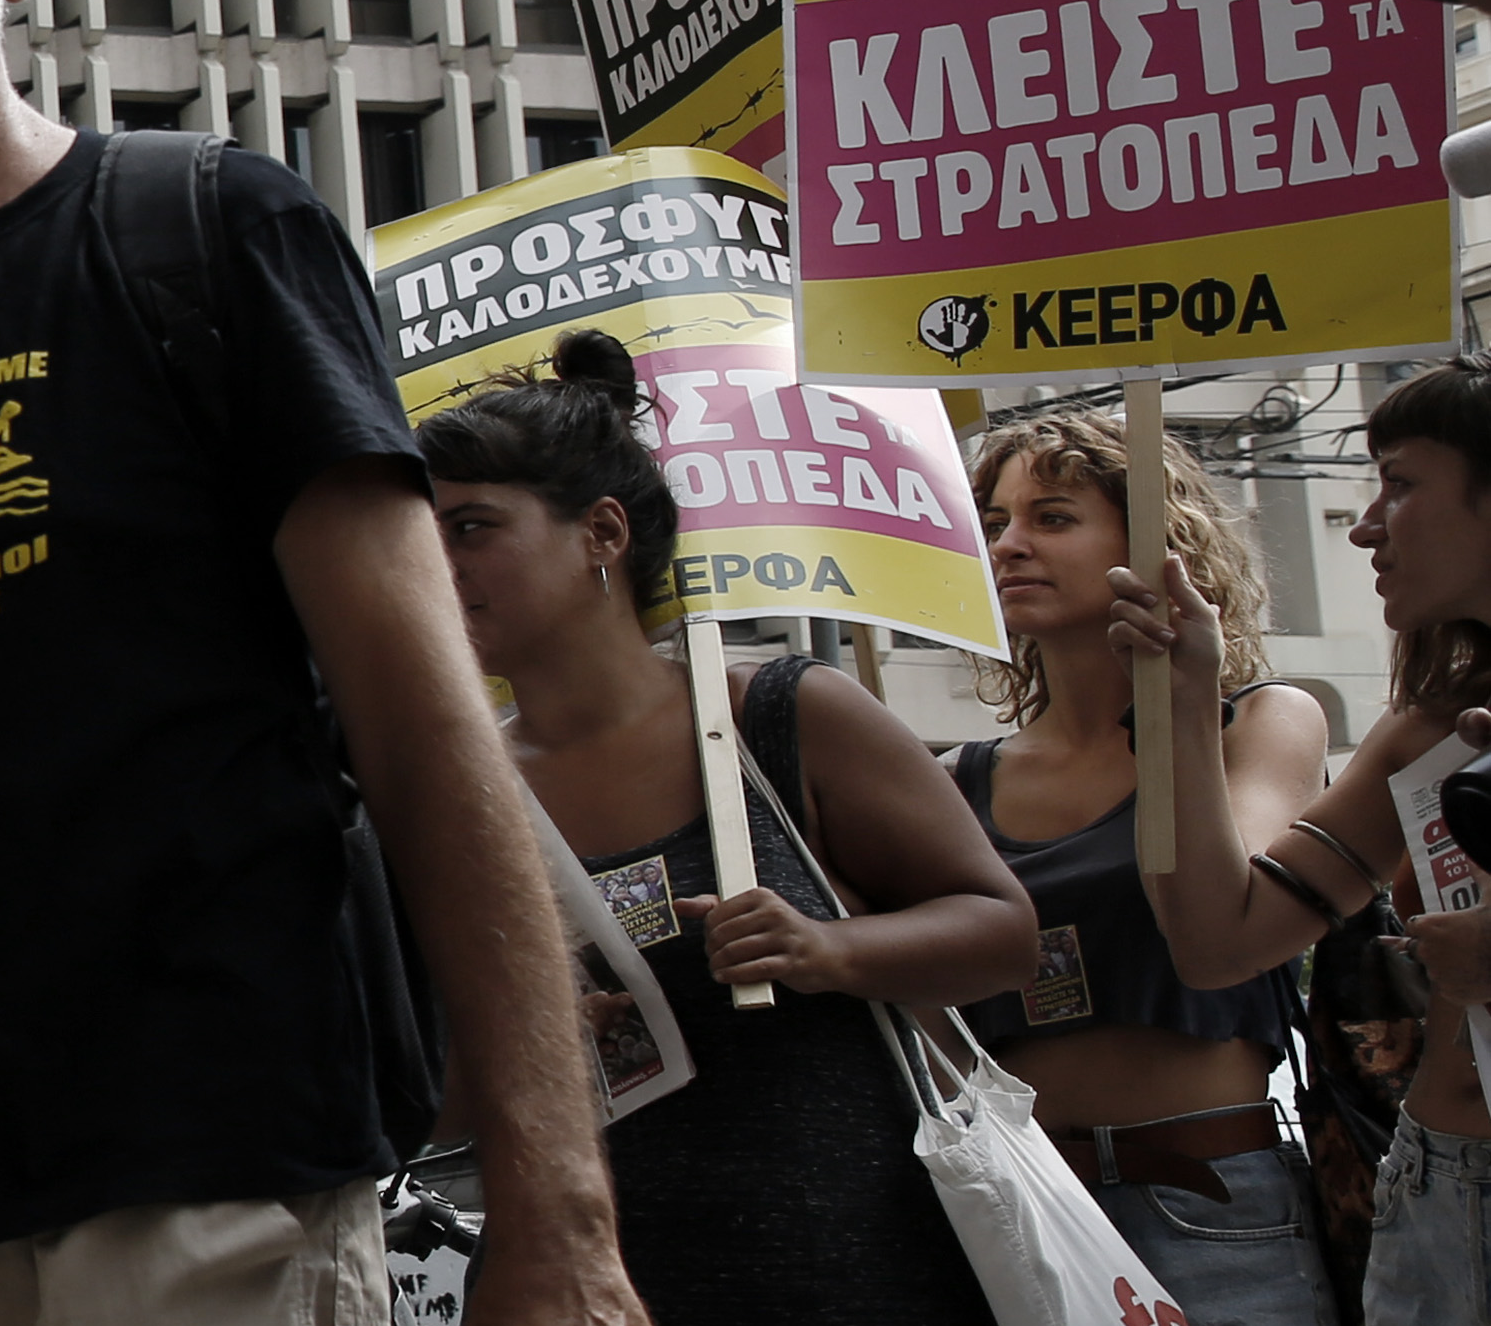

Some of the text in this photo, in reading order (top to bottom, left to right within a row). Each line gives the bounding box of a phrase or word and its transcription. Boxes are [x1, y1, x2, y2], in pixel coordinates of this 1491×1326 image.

[827, 82, 1420, 248] ΣΤΡΑΤΟΠΕΔΑ
[394, 193, 790, 321] ΠΡΟΣΦΥΓ
[1012, 273, 1288, 352] ΚΕΕΡΦΑ
